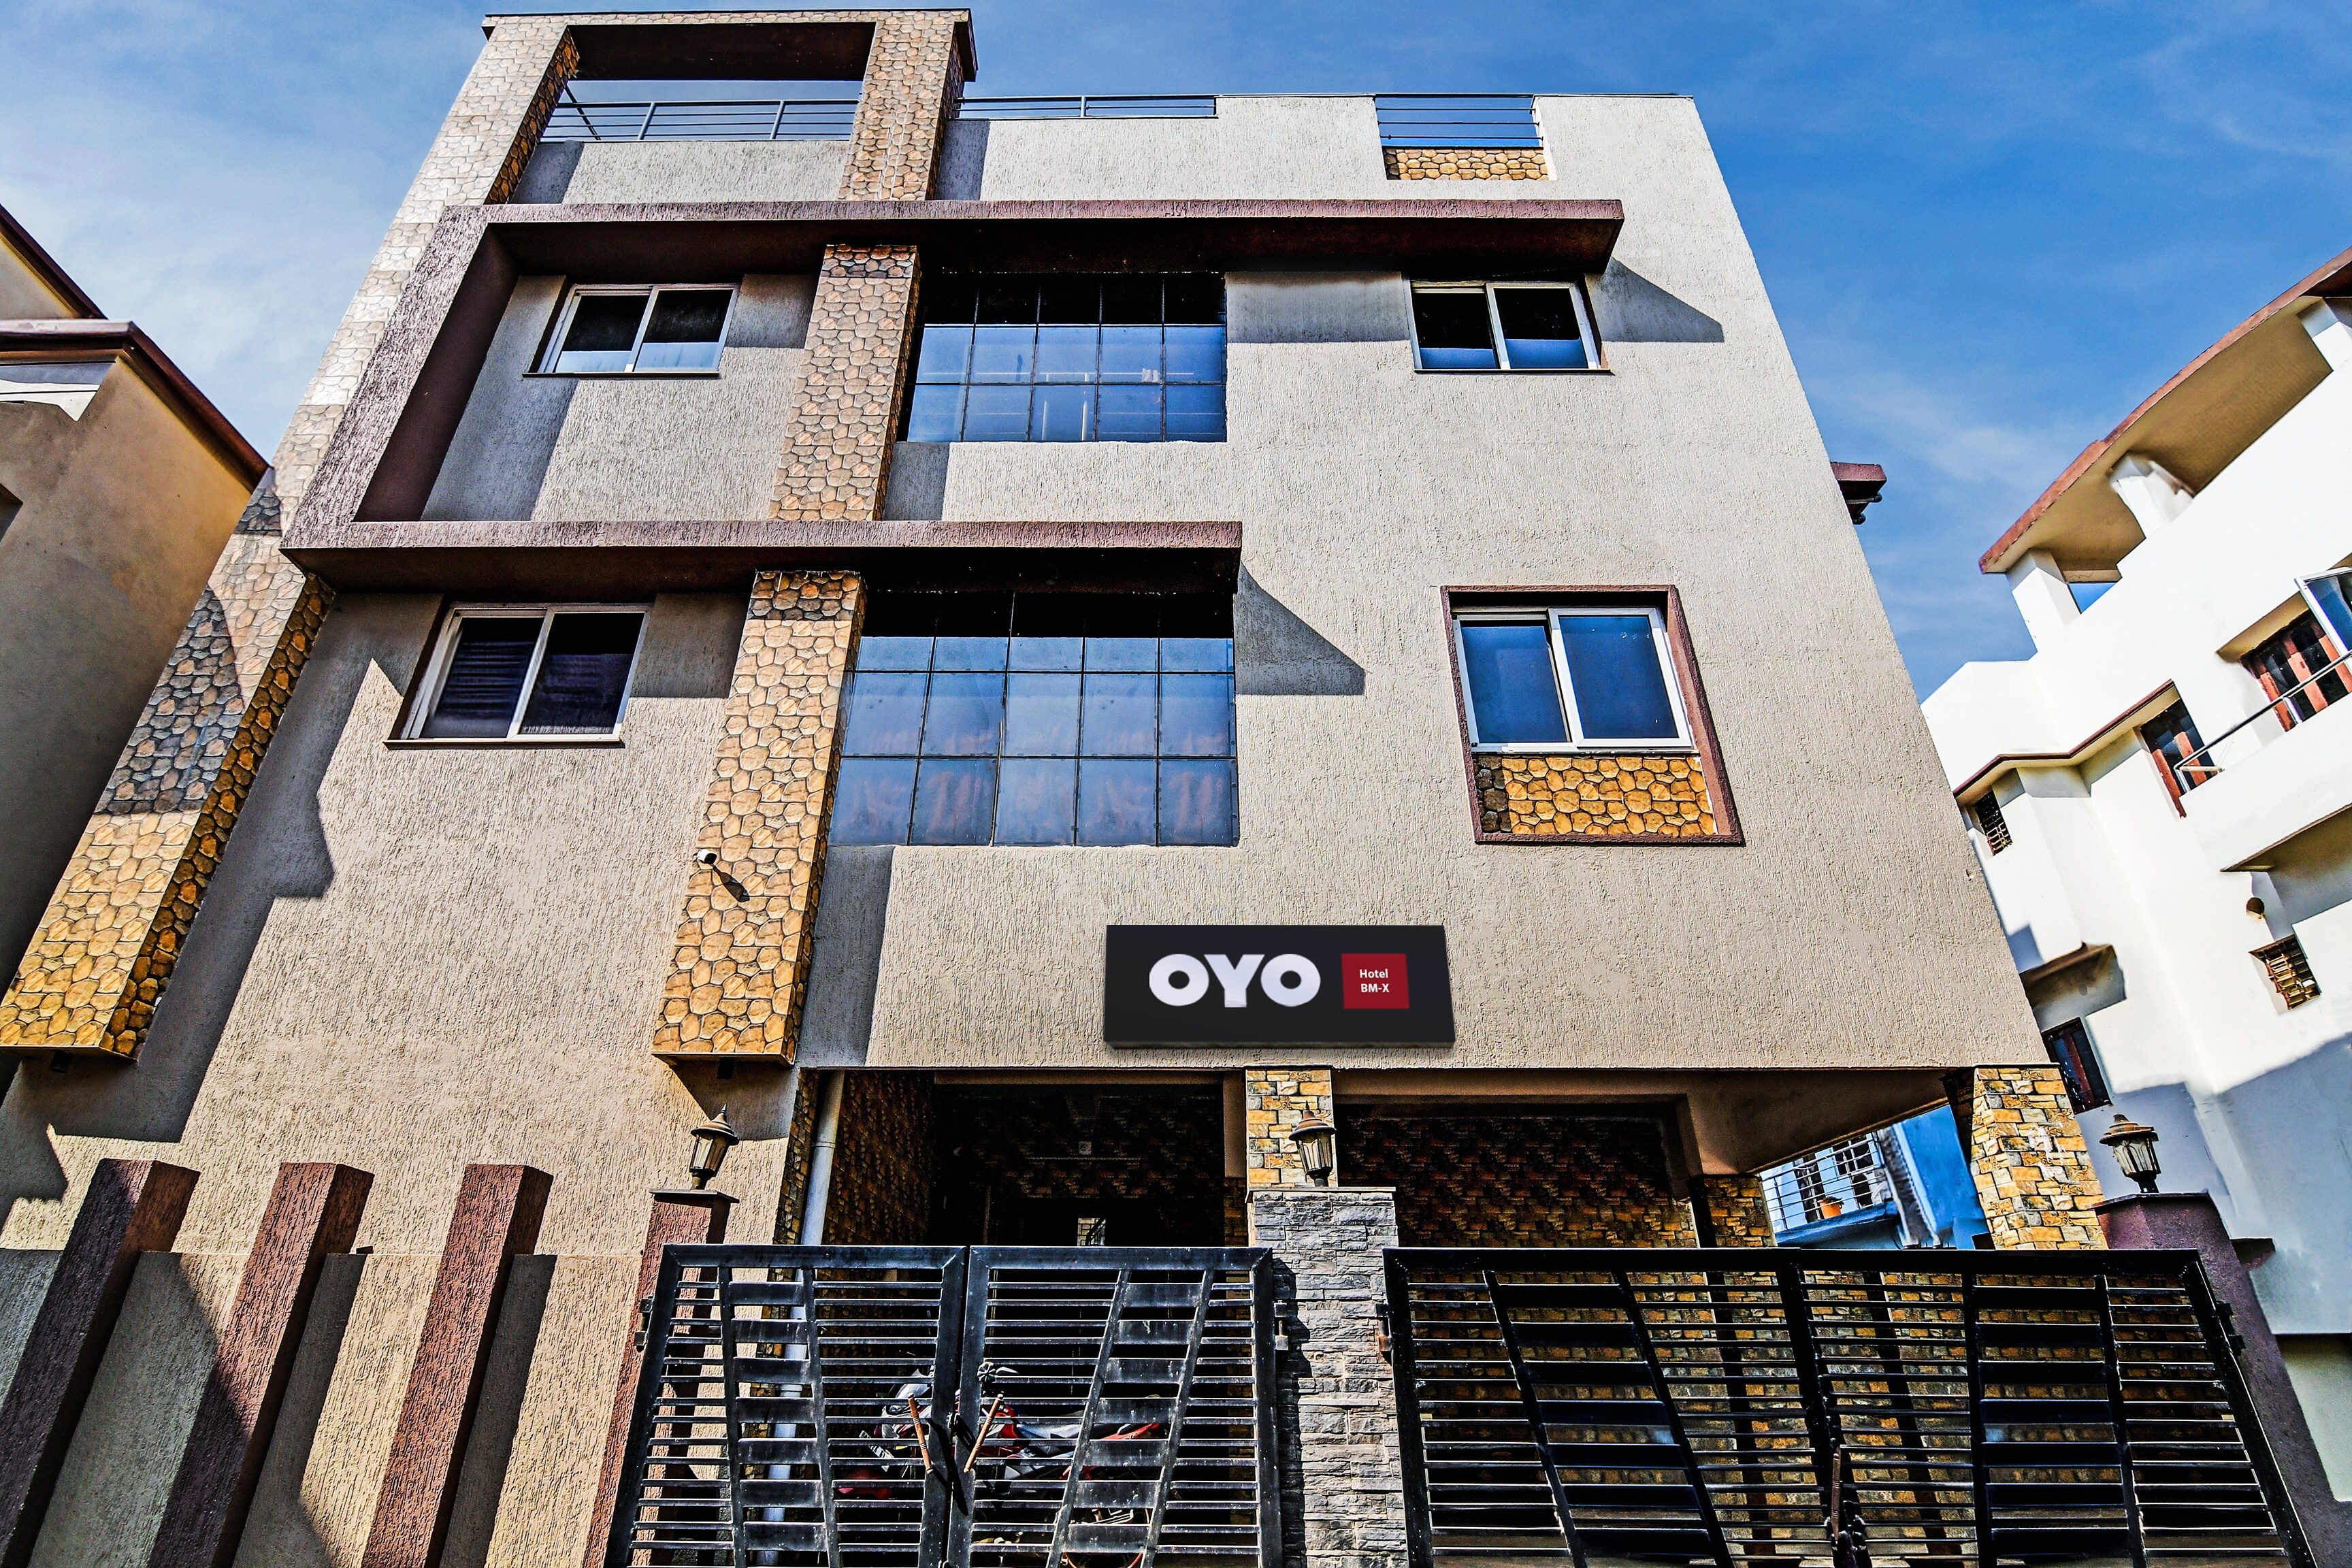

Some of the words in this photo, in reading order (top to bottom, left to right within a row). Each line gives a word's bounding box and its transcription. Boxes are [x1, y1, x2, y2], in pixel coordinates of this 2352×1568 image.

[1359, 968, 1388, 979] Hotel
[1149, 953, 1321, 1008] OYO
[1360, 983, 1390, 993] BM-X
